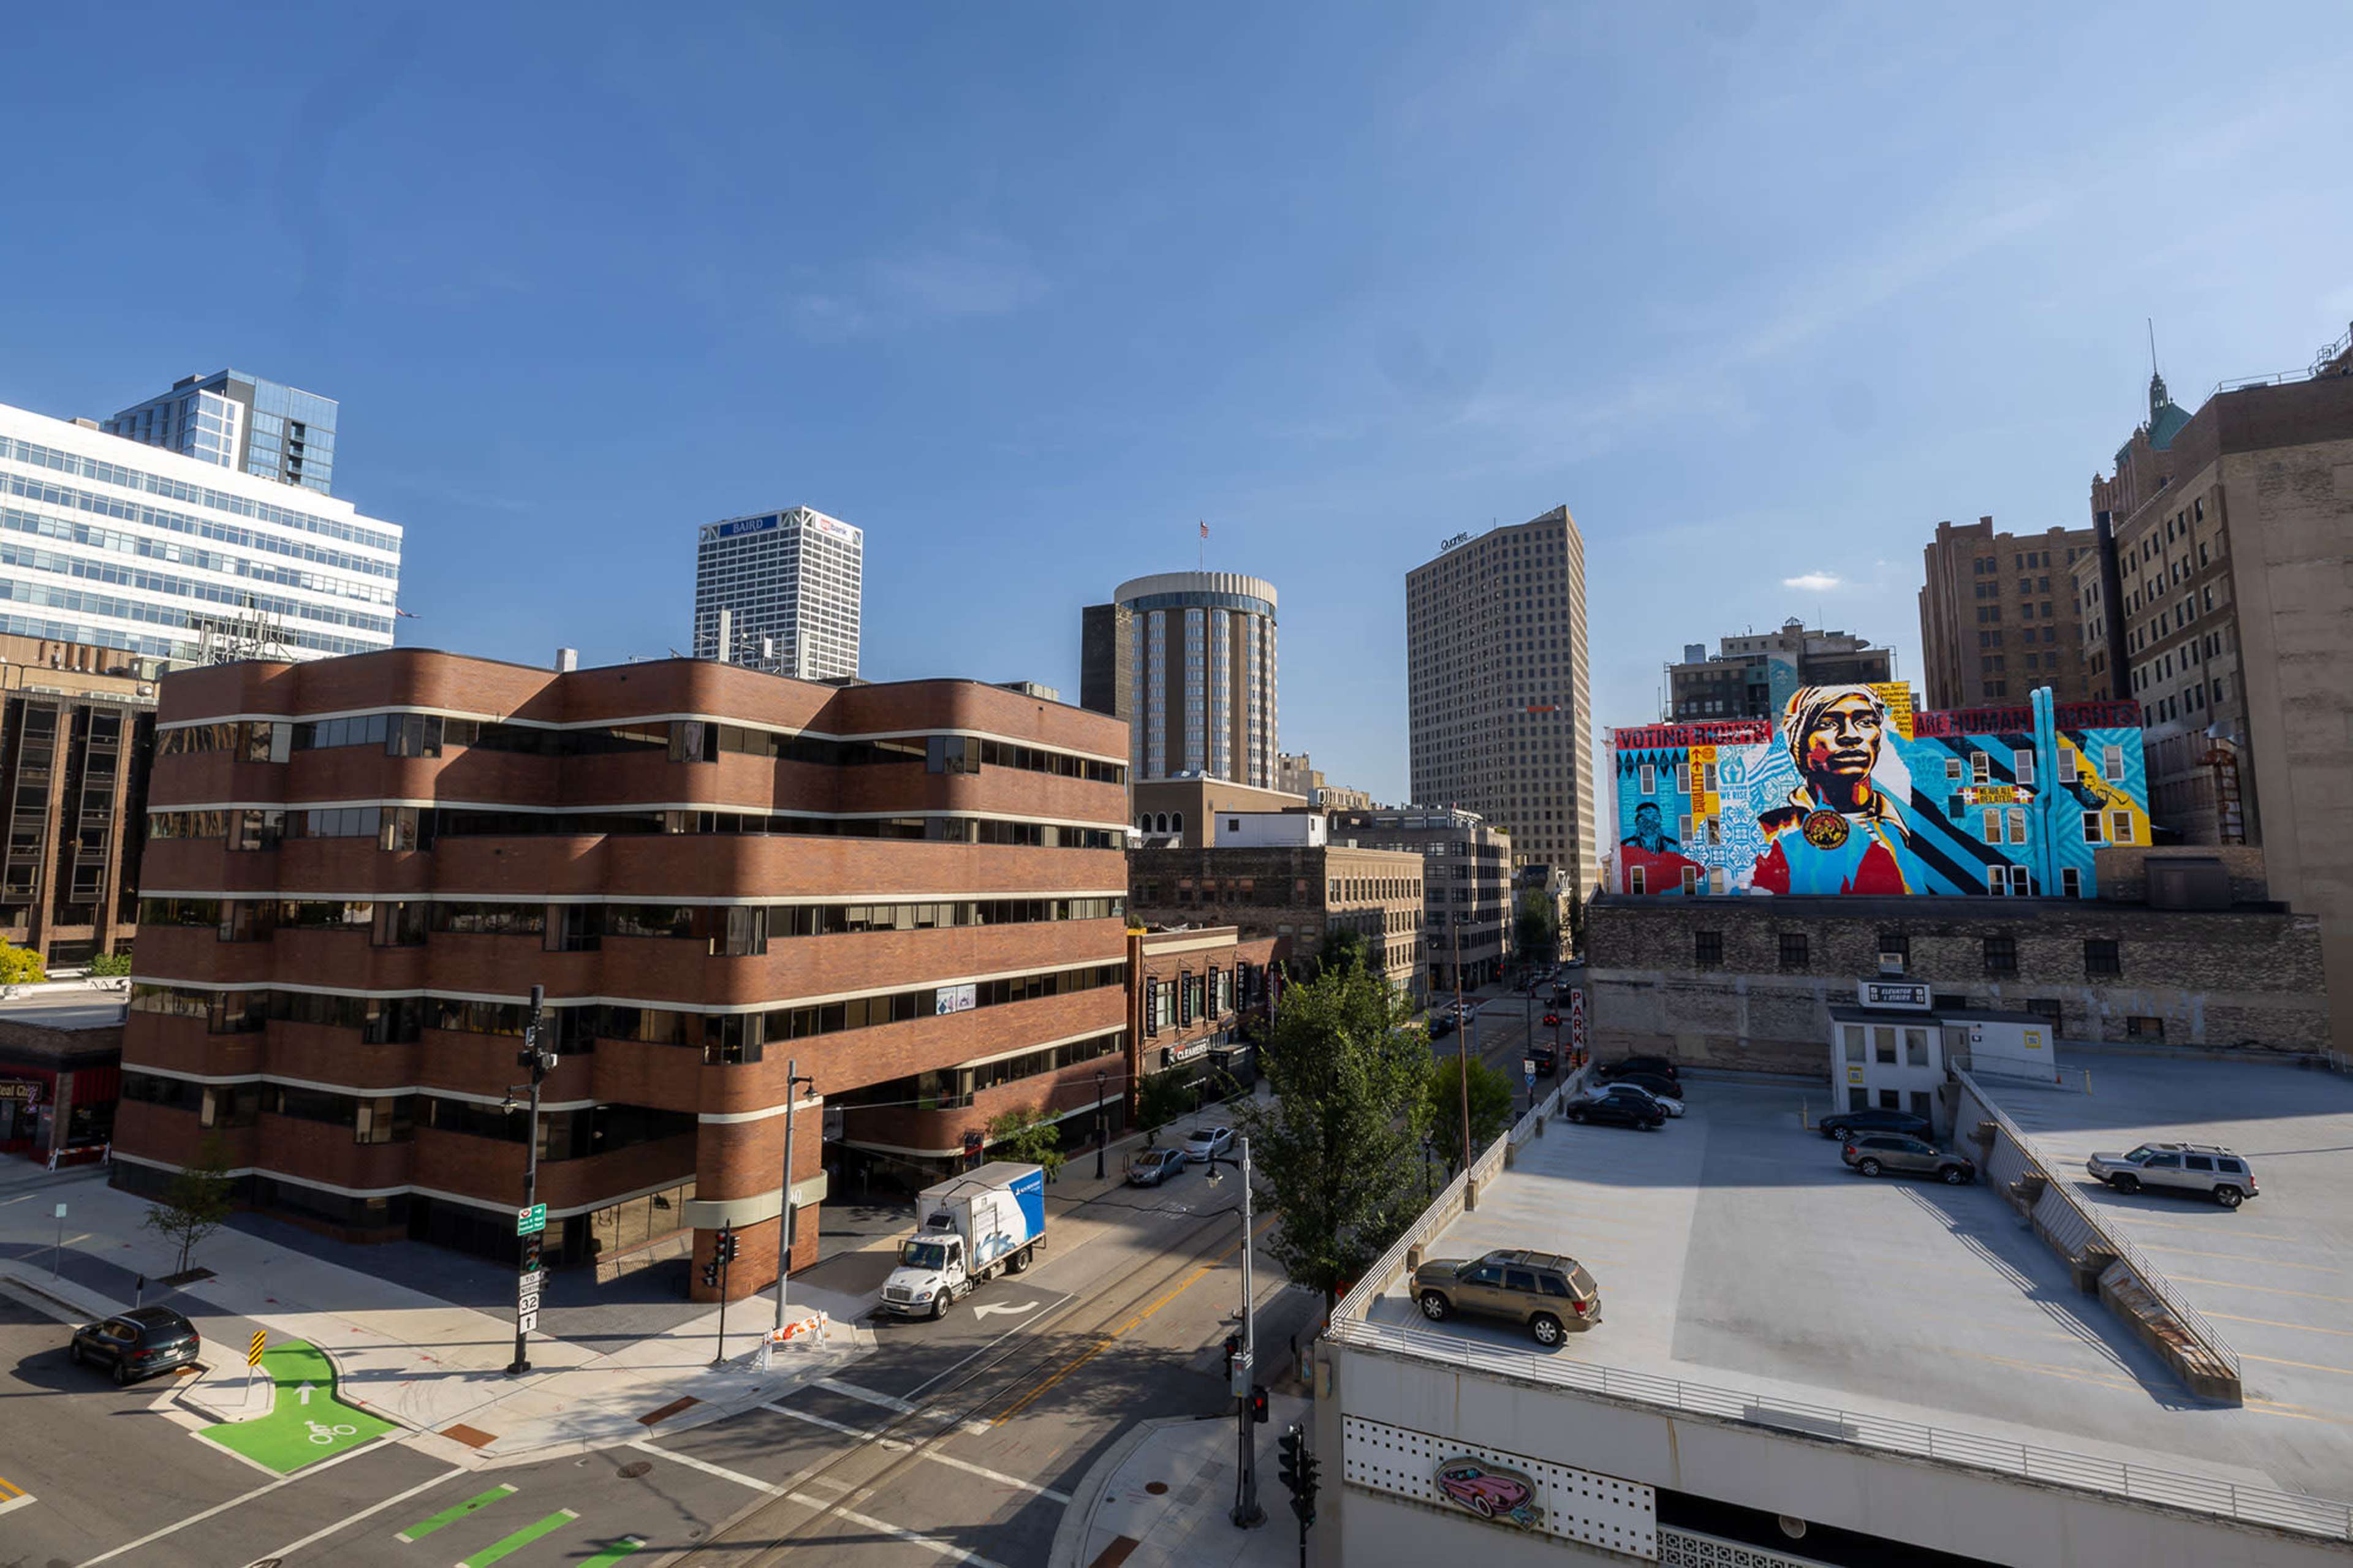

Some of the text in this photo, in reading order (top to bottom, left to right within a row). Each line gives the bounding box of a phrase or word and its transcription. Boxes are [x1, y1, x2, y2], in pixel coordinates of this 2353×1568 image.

[733, 519, 763, 533] BAIRD
[1916, 703, 2134, 735] ARE HUMAN RIGHTS
[1620, 724, 1765, 747] VOTING RIGHTS
[1691, 773, 1705, 813] EQUALITY
[1720, 790, 1748, 800] WE RISE
[1572, 992, 1582, 1044] PARK
[1176, 1043, 1207, 1060] CLEANERS
[0, 1085, 15, 1097] eal
[521, 1296, 537, 1311] 32
